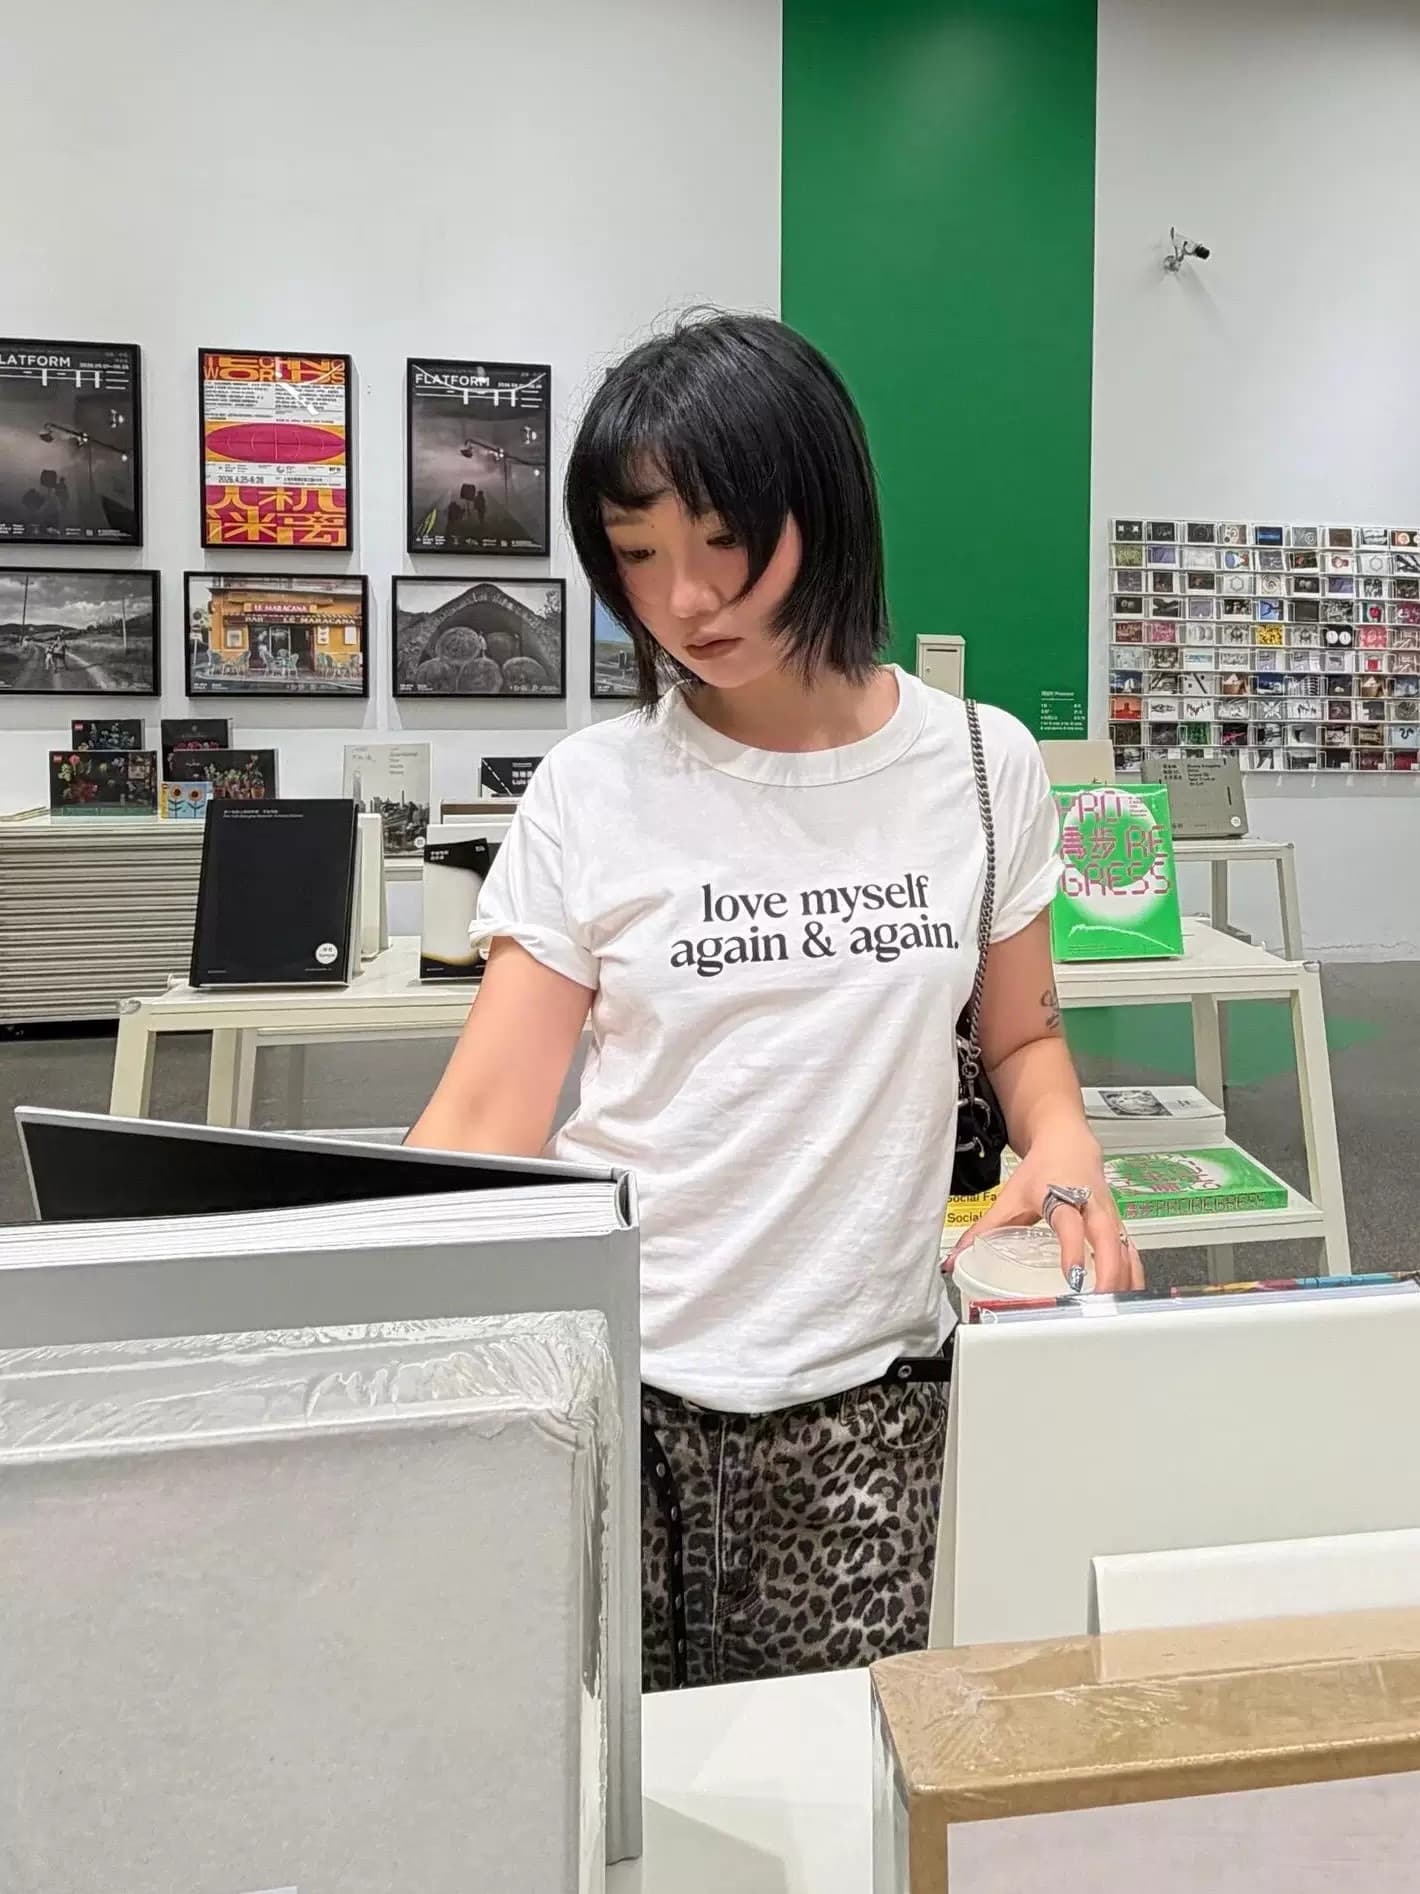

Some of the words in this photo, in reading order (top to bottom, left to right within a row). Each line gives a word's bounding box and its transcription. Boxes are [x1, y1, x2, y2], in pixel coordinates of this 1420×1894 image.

[702, 884, 788, 922] love
[800, 873, 929, 923] myself
[1061, 862, 1170, 897] GRESS
[670, 926, 789, 977] again
[802, 921, 836, 958] &
[850, 914, 959, 963] again.
